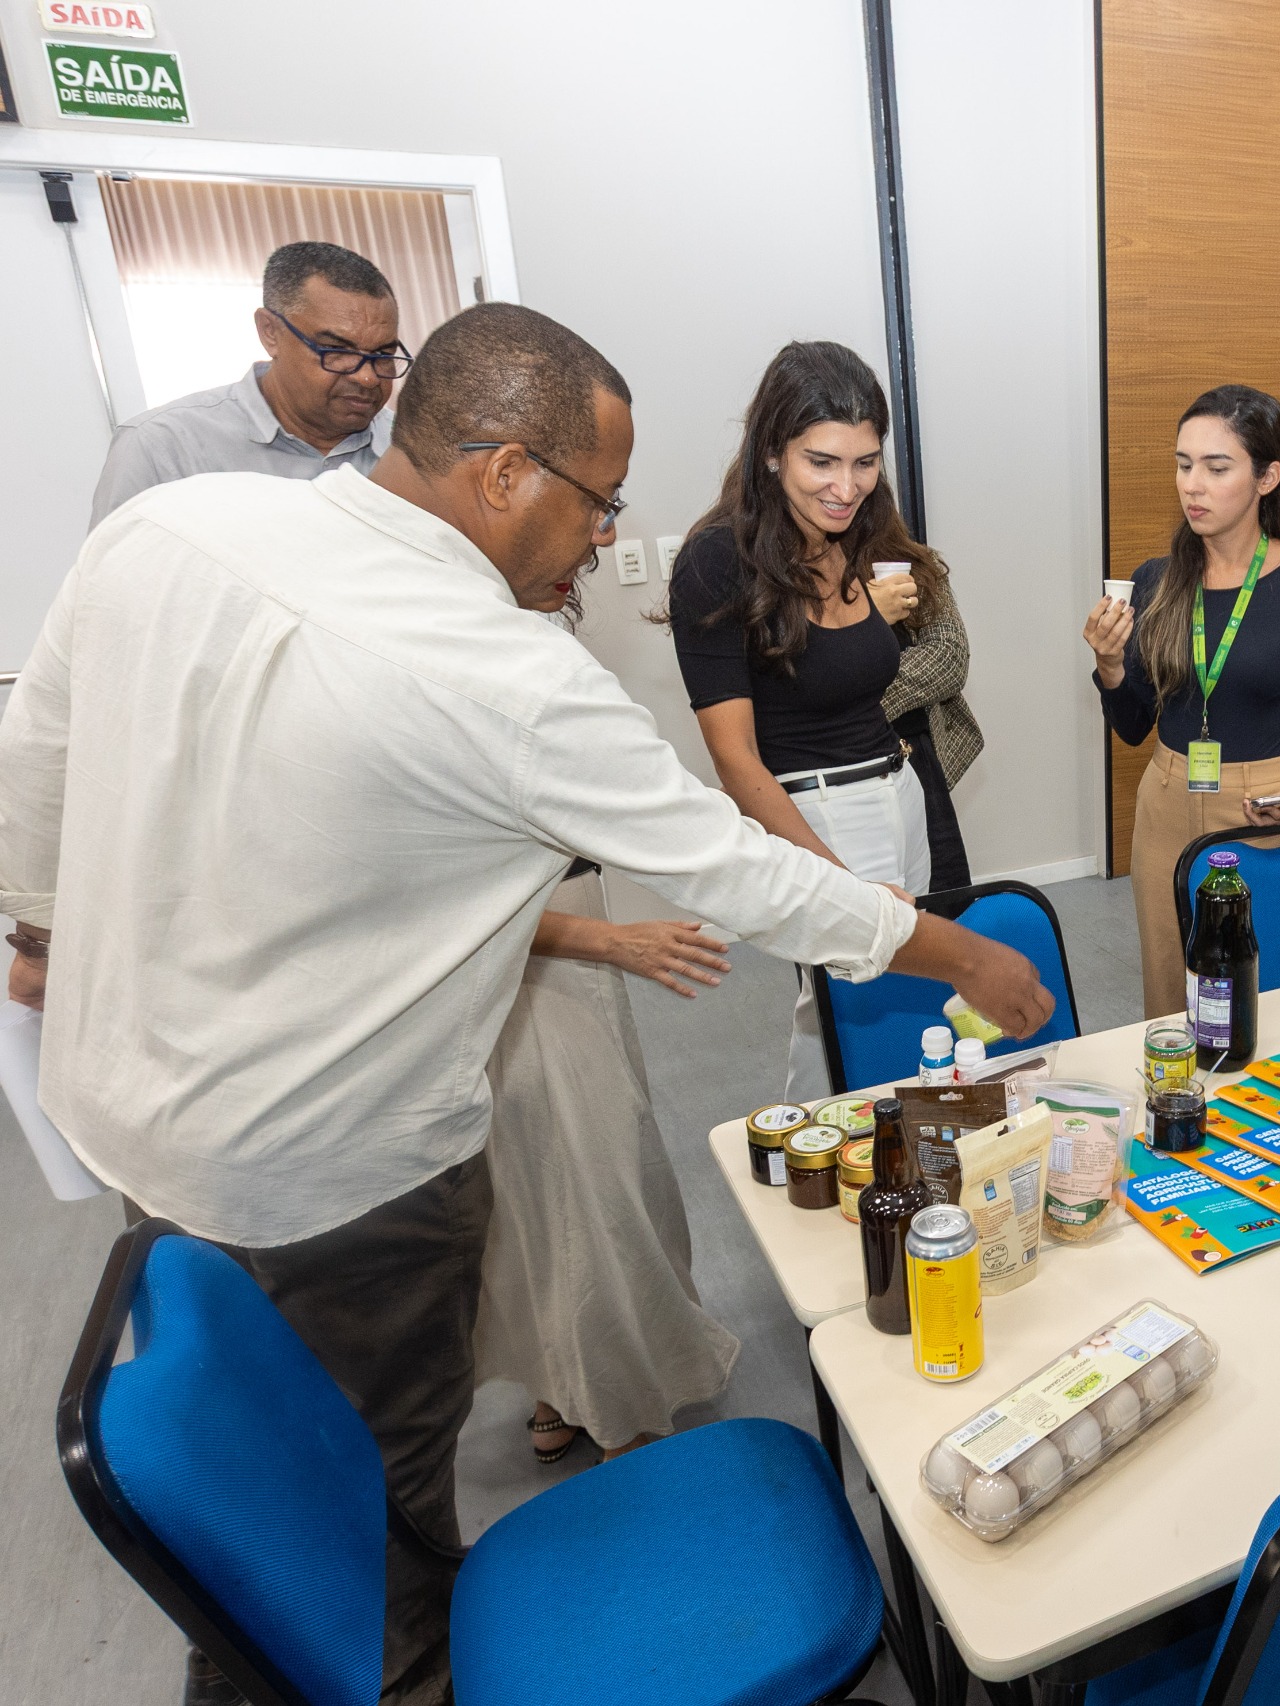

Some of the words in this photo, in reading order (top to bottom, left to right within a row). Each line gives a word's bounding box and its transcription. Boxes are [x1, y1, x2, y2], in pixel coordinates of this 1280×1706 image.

[55, 54, 179, 95] SAÍDA
[60, 88, 83, 103] DE
[85, 89, 183, 111] EMERGÊNCIA
[1150, 1185, 1212, 1206] FAMILIAR
